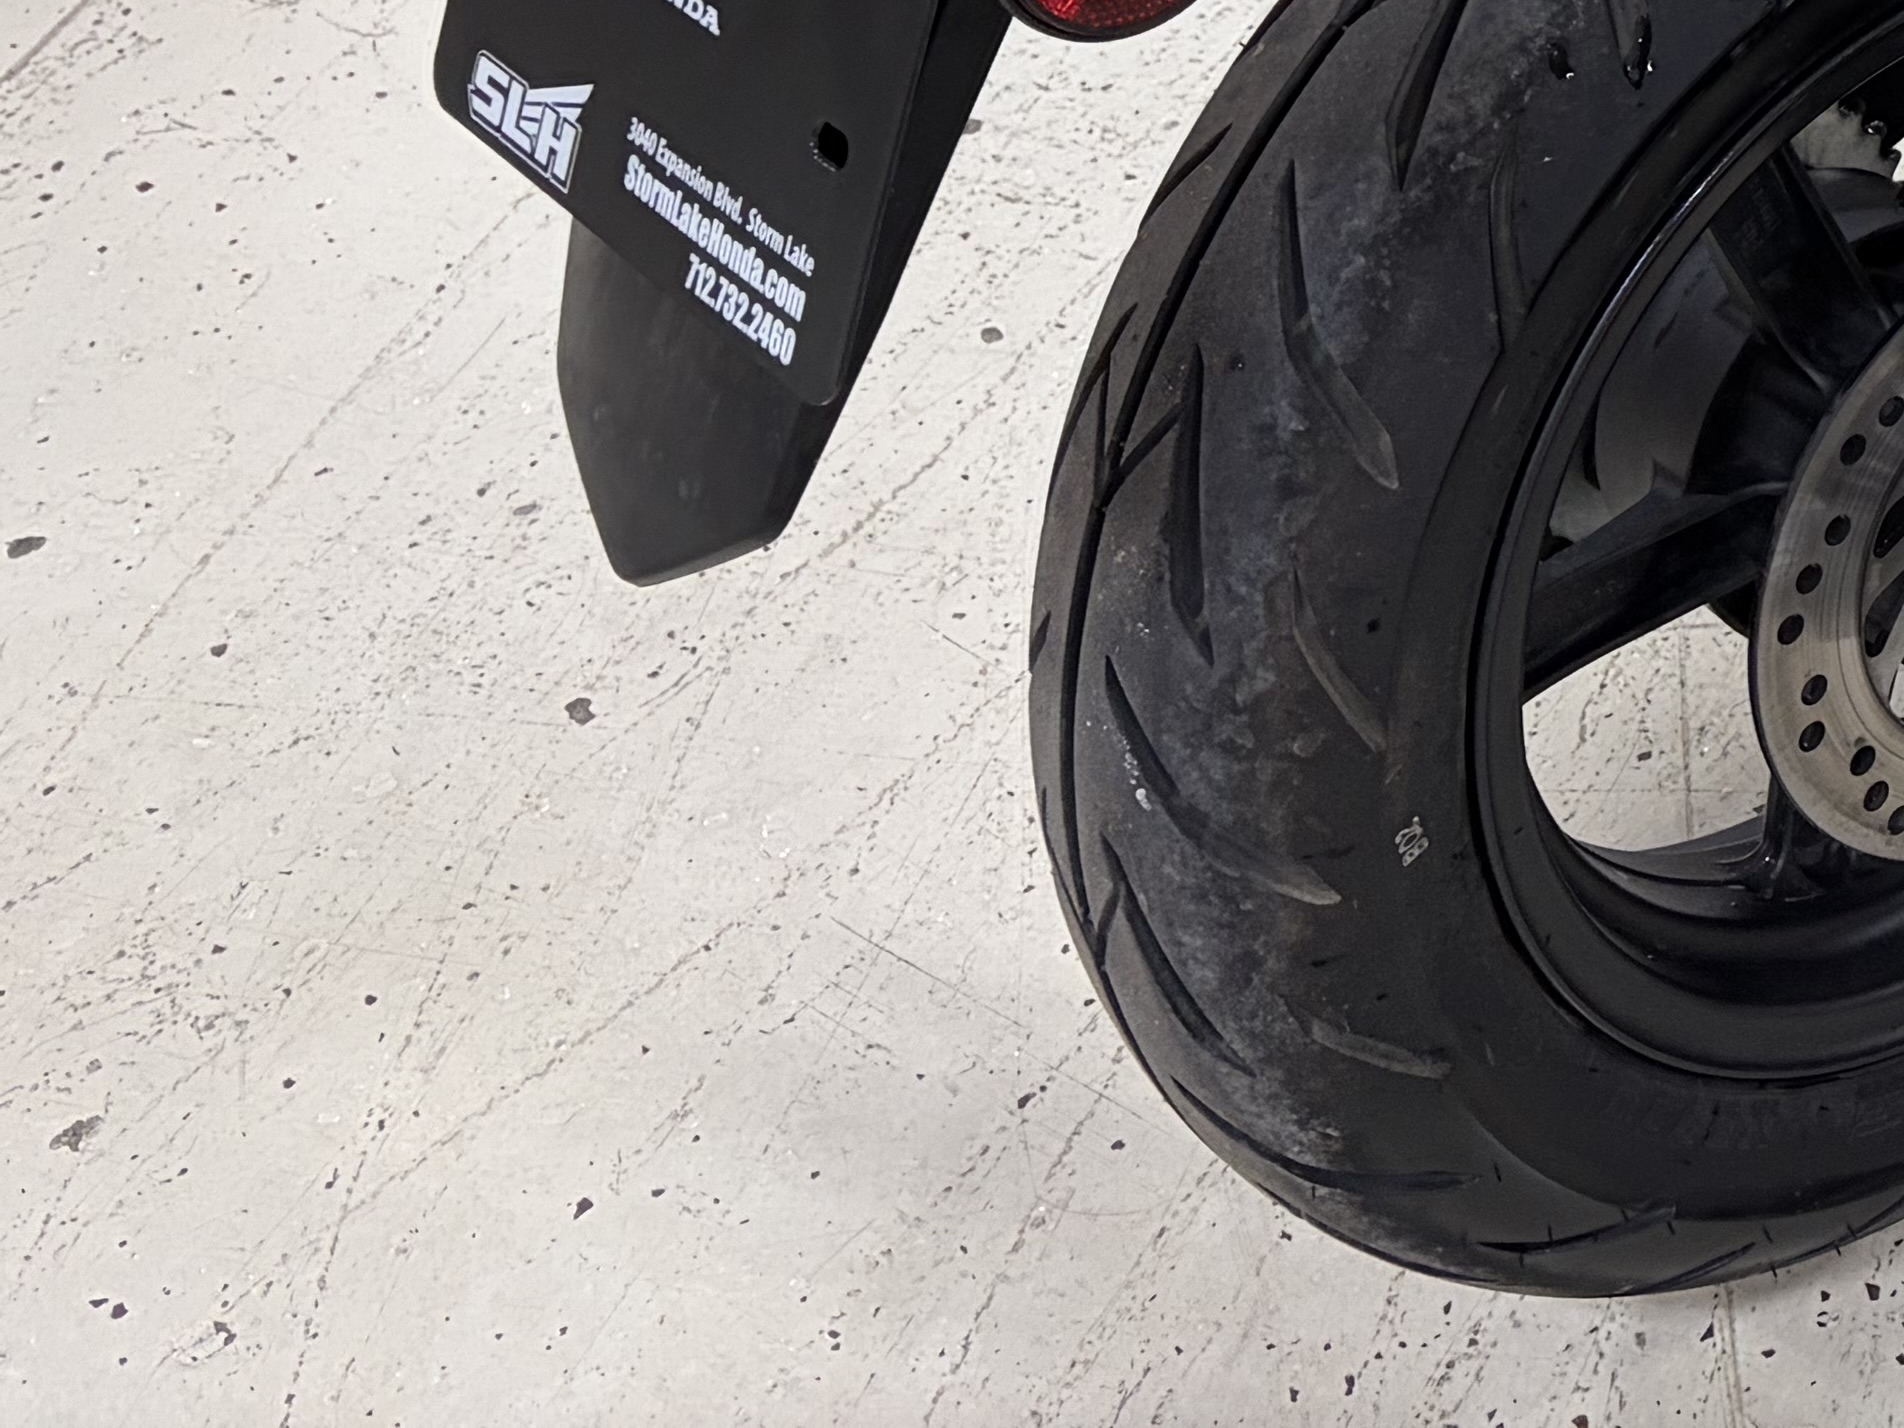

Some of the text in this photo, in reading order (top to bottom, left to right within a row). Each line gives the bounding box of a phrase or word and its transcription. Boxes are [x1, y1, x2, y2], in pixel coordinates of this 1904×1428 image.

[469, 51, 581, 192] SLH
[626, 116, 815, 277] 3040 Expansion Blvd. Storm Lake
[623, 154, 807, 322] StormLakeHonda.com
[684, 254, 796, 366] 712.732.2460
